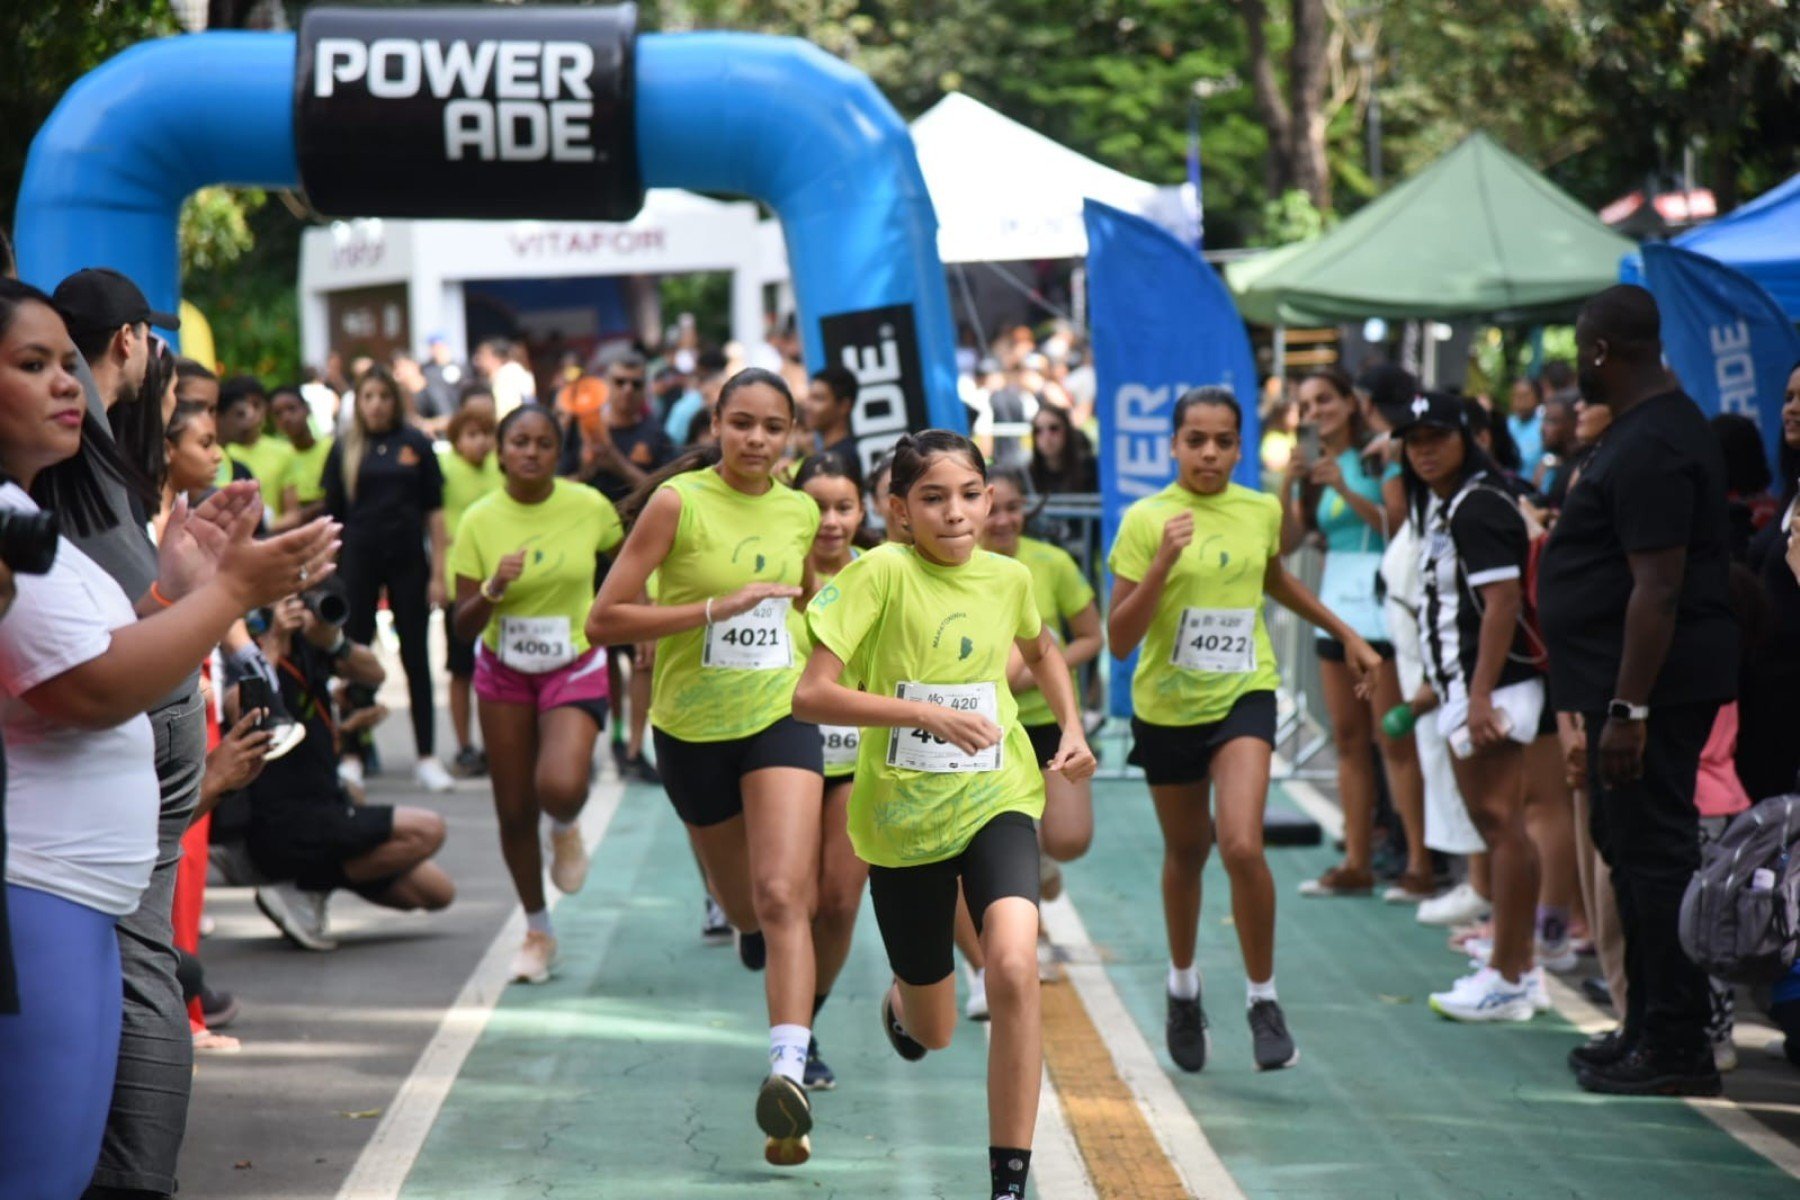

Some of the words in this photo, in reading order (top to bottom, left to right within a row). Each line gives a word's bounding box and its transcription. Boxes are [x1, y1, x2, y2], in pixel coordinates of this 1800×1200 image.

[314, 38, 594, 99] POWER
[444, 99, 594, 161] ADE
[510, 230, 665, 257] VITAFOR
[721, 627, 779, 647] 4021
[1190, 635, 1247, 653] 4022
[951, 697, 978, 710] 420
